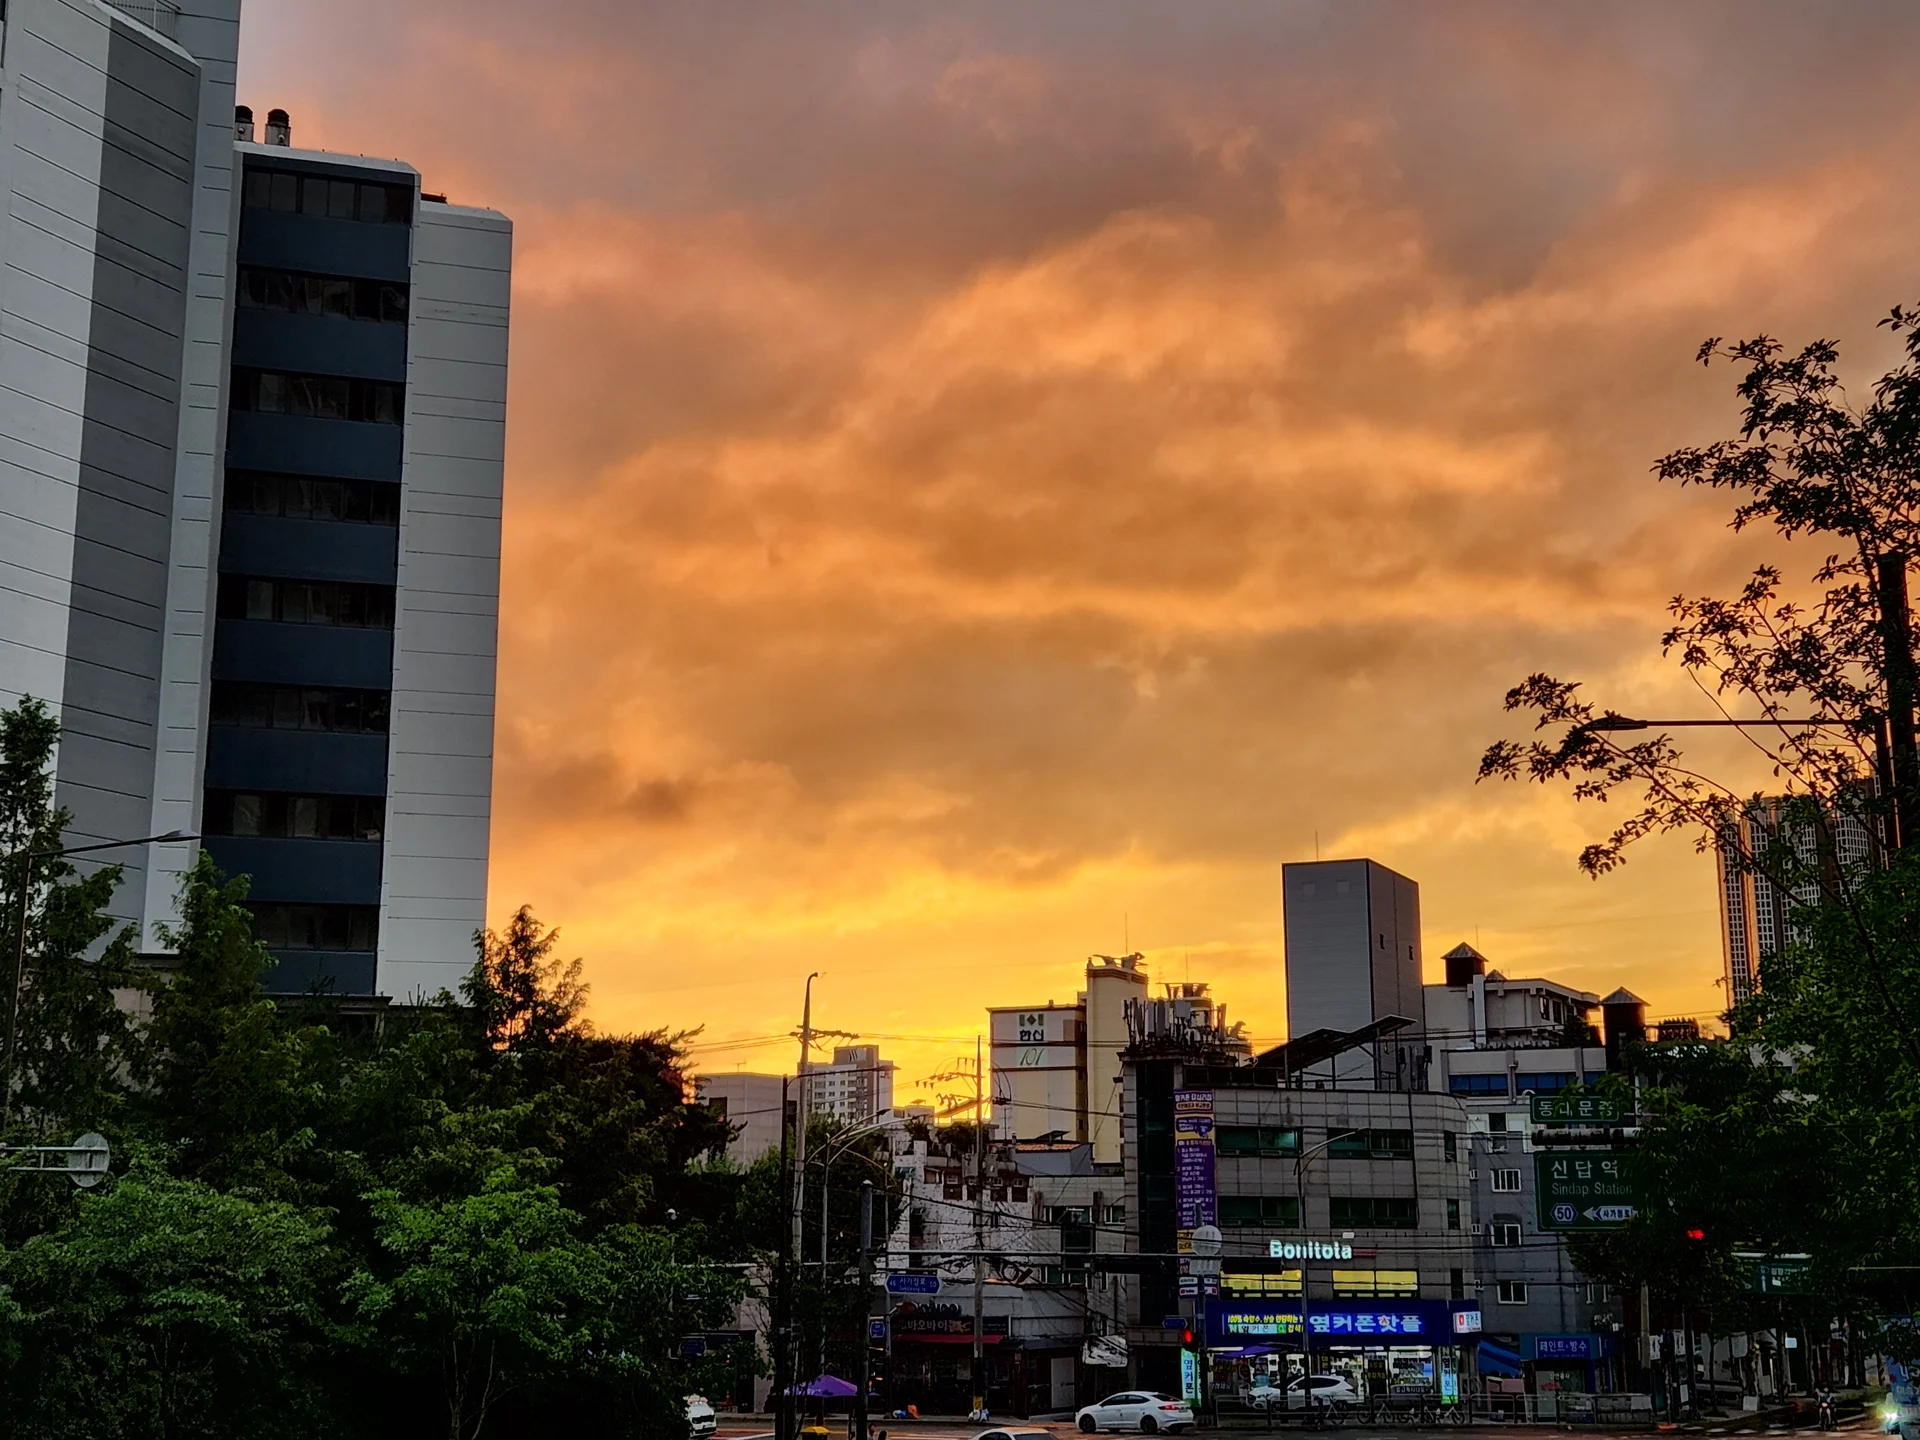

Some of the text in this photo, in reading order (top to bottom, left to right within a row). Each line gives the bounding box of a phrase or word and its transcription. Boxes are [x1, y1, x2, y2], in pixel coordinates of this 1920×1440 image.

[1020, 1048, 1045, 1066] 101
[1550, 1159, 1618, 1179] 신답역
[1551, 1181, 1633, 1197] Sindap Station
[1556, 1207, 1571, 1220] 50
